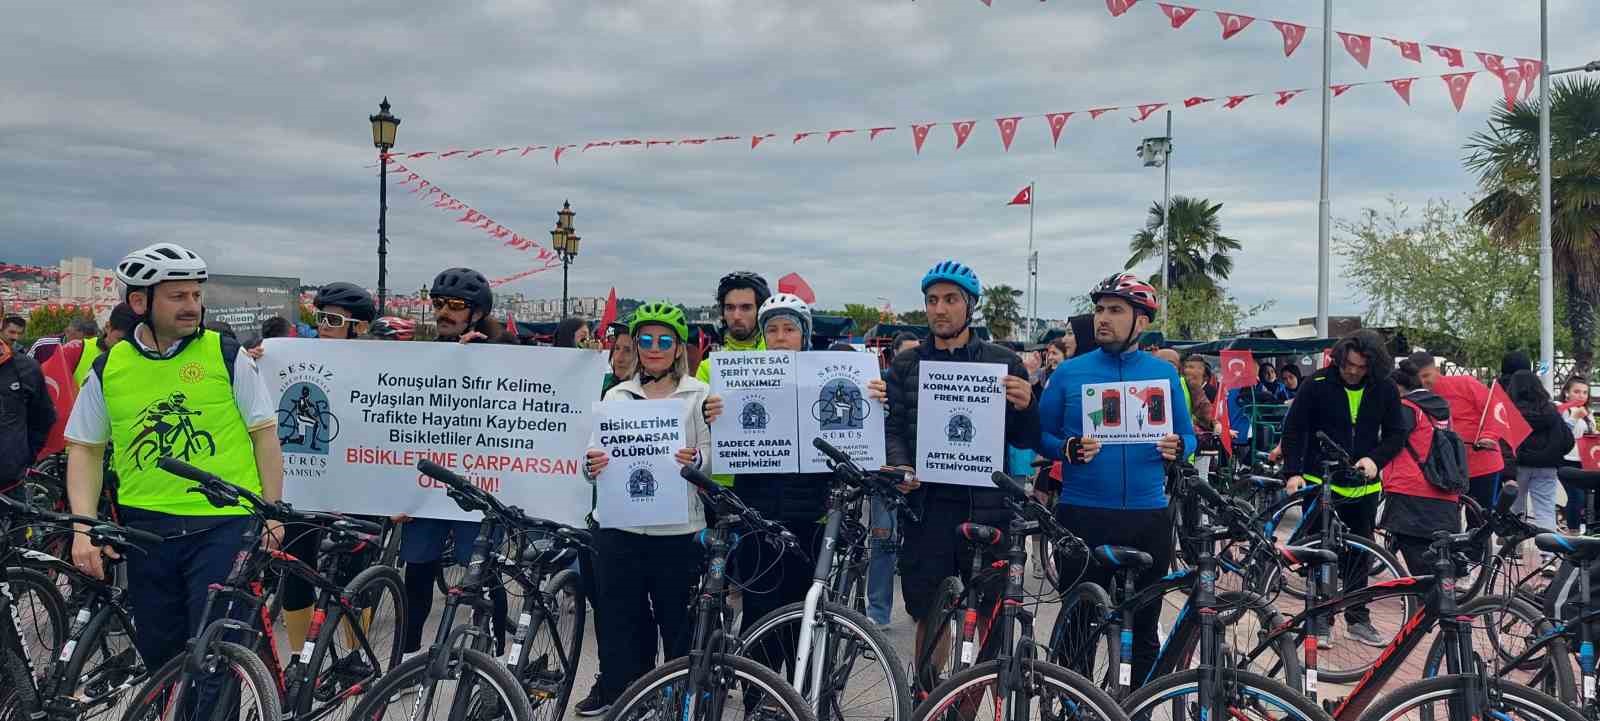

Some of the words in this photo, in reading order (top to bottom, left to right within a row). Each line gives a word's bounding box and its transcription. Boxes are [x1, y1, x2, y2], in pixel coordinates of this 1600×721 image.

[716, 355, 766, 366] TRAFİKTE
[769, 355, 790, 365] SAĞ
[720, 367, 750, 378] ŞERİT
[752, 367, 787, 376] YASAL
[377, 372, 457, 391] Konuşulan
[462, 375, 493, 390] Sıfır
[496, 377, 556, 396] Kelime,
[726, 379, 781, 388] HAKKIMIZ!
[928, 373, 955, 381] YOLU
[957, 374, 998, 386] PAYLAŞ!
[922, 383, 971, 393] KORNAYA
[972, 383, 1002, 395] DEĞİL
[350, 390, 424, 408] Paylaşılan
[429, 393, 517, 412] Milyonlarca
[522, 397, 582, 414] Hatıra...
[933, 394, 965, 403] FRENE
[966, 395, 990, 404] BAS!
[361, 409, 418, 425] Trafikte
[422, 411, 482, 430] Hayatını
[486, 414, 567, 433] Kaybeden
[600, 416, 679, 431] BİSİKLETİME
[389, 428, 473, 446] Bisikletliler
[475, 432, 534, 450] Anısına
[600, 431, 679, 447] ÇARPARSAN
[717, 440, 756, 448] SADECE
[758, 439, 792, 447] ARABA
[611, 445, 670, 458] ÖLÜRÜM!
[752, 449, 791, 457] YOLLAR
[926, 451, 957, 460] ARTIK
[957, 452, 992, 463] ÖLMEK
[288, 455, 328, 468] ÜRÜŞ
[346, 444, 458, 468] BİSİKLETİME
[462, 453, 578, 475] ÇARPARSAN
[728, 459, 781, 468] HEPİMİZİN!
[925, 459, 993, 473] İSTEMİYORUZ!
